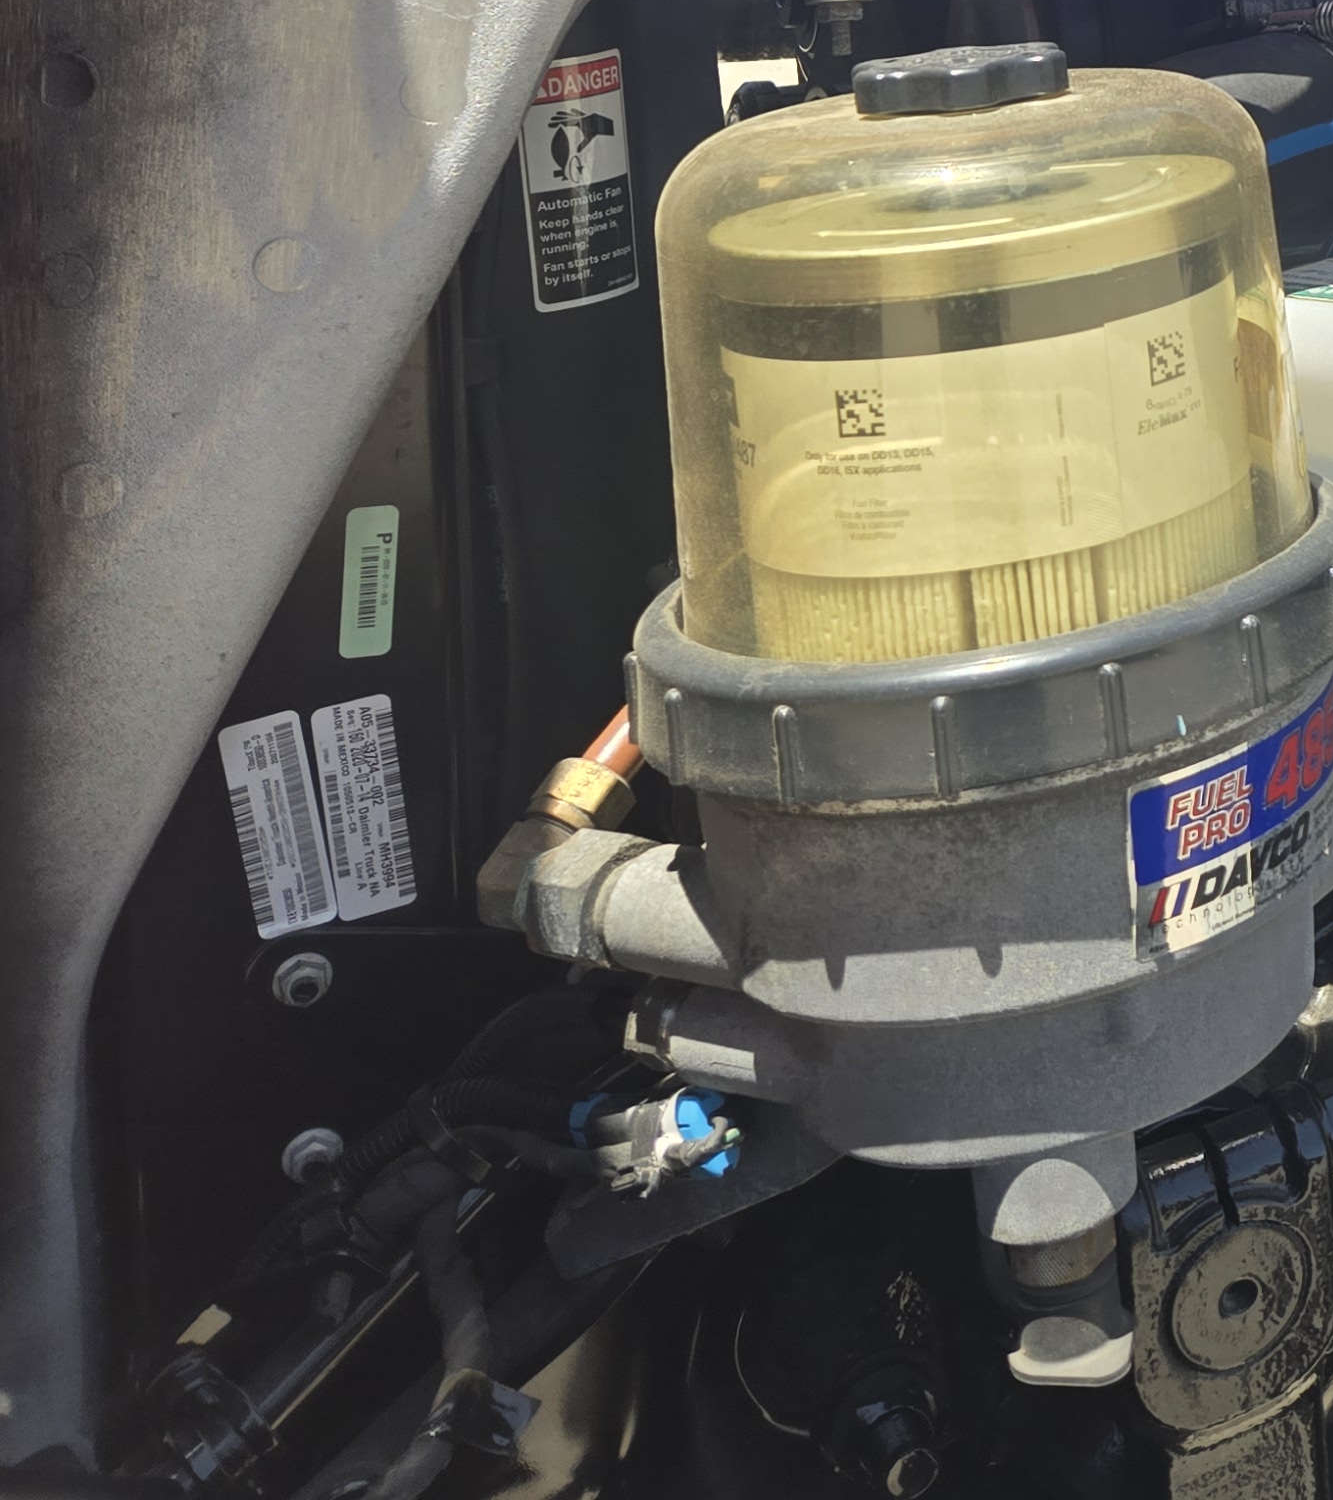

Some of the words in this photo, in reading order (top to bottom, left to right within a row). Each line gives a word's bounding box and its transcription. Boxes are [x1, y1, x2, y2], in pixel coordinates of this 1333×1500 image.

[548, 65, 619, 97] DANGER
[537, 191, 603, 212] Automatic
[605, 186, 621, 199] Fan
[539, 218, 569, 230] Keep
[572, 210, 603, 225] hands
[605, 204, 624, 216] clear
[540, 231, 571, 242] when
[574, 222, 607, 237] engine
[610, 219, 617, 228] is
[541, 240, 589, 255] running.
[543, 262, 565, 272] Fan
[567, 255, 599, 269] starts
[601, 252, 611, 261] or
[612, 245, 632, 258] stops
[544, 276, 559, 287] by
[562, 268, 594, 283] itself.
[862, 463, 922, 477] applications
[332, 706, 343, 731] MADE
[335, 732, 344, 742] IN
[337, 743, 350, 777] MEXICO
[1166, 764, 1254, 830] FUEL
[358, 805, 371, 847] Daimler
[1177, 798, 1252, 861] PRO
[364, 848, 376, 879] Truck
[378, 841, 396, 888] MH3994
[1190, 810, 1311, 909] DAVCO
[357, 881, 367, 891] A
[369, 880, 381, 898] NA
